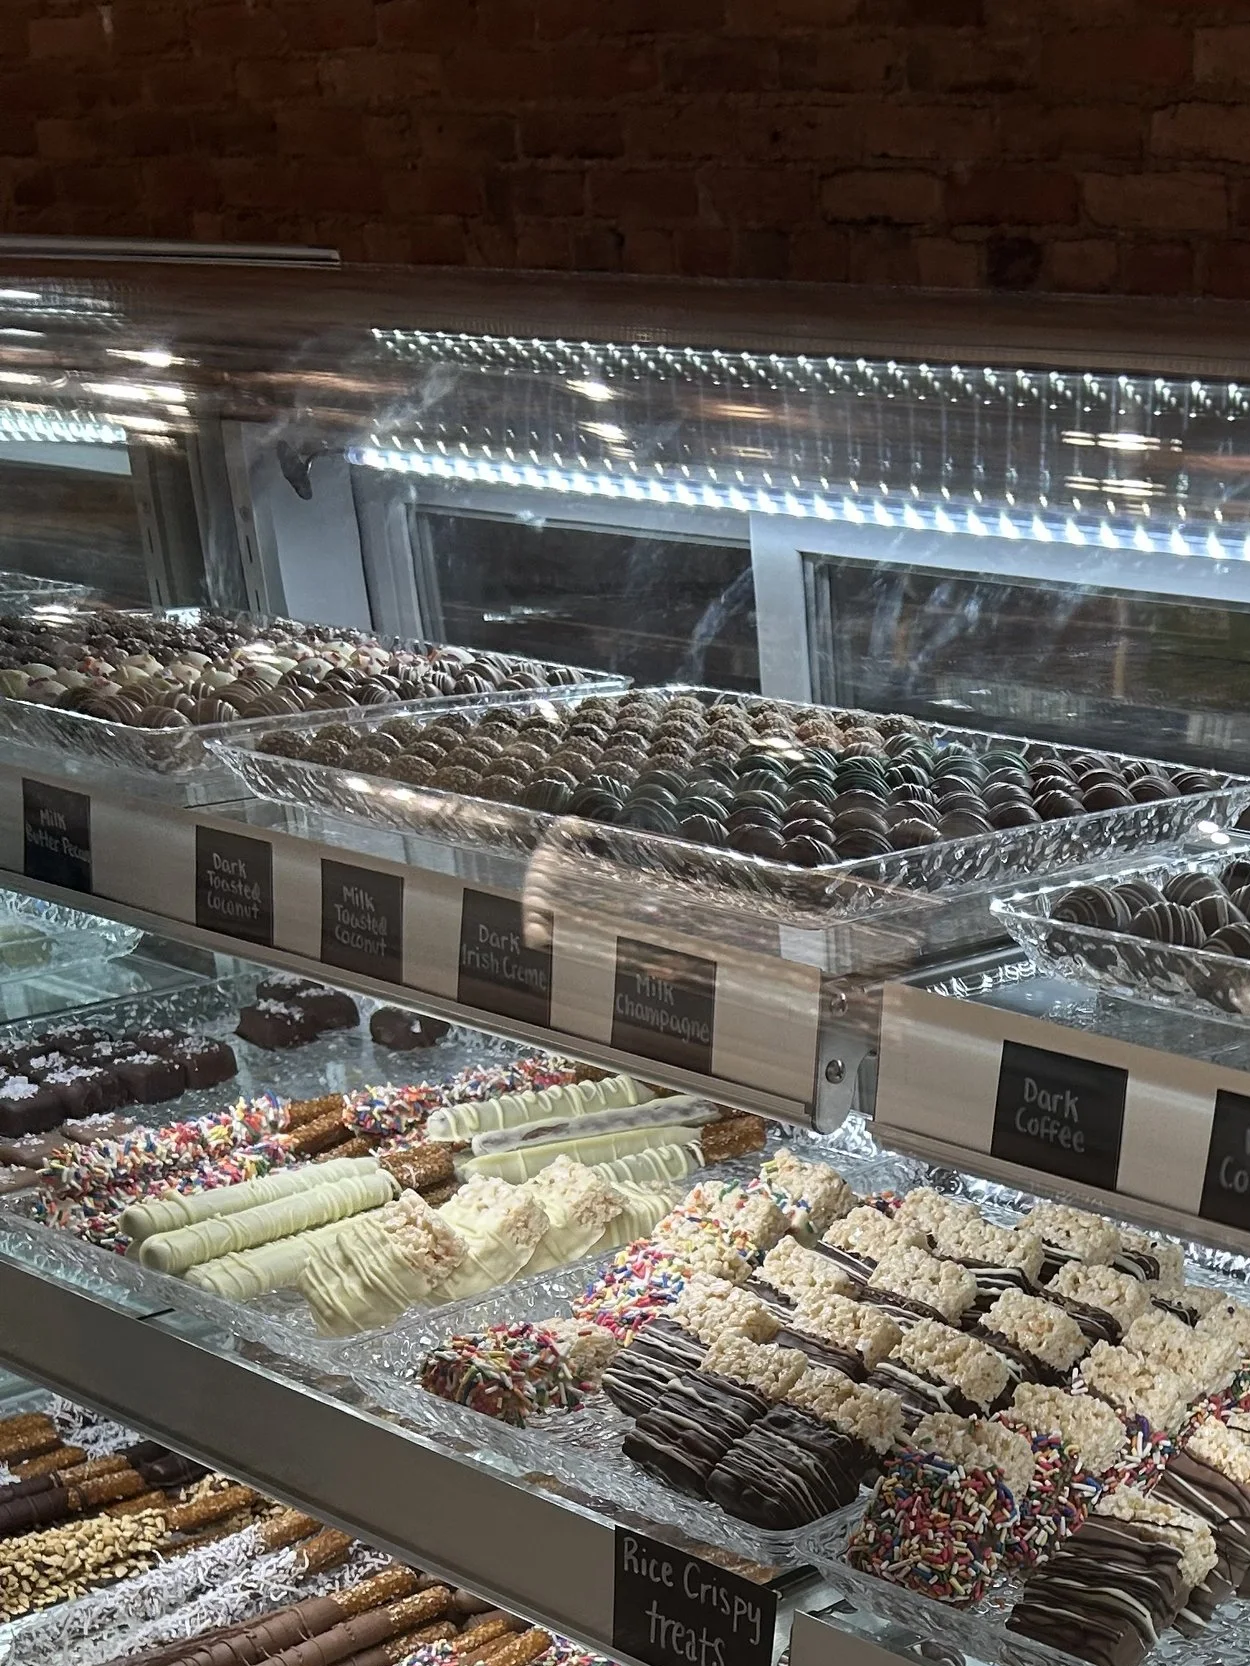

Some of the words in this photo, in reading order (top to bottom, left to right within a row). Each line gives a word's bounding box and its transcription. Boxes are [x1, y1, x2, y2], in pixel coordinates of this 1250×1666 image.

[40, 808, 67, 831] Milk
[25, 820, 60, 852] Butter
[213, 852, 247, 879] Dark
[207, 870, 262, 903] Toasted
[343, 885, 376, 912] Milk
[207, 891, 260, 920] Coconut
[334, 904, 388, 936] Toasted
[335, 924, 387, 956] Coconut
[479, 924, 520, 954] Dark
[461, 943, 499, 974] Irish
[502, 958, 547, 991] Creme
[636, 974, 675, 1005] Milk
[616, 993, 710, 1044] Champagne
[1023, 1077, 1079, 1123] Dark
[1014, 1106, 1085, 1153] Coffee
[623, 1536, 674, 1587] Rice
[683, 1562, 762, 1646] Crispy
